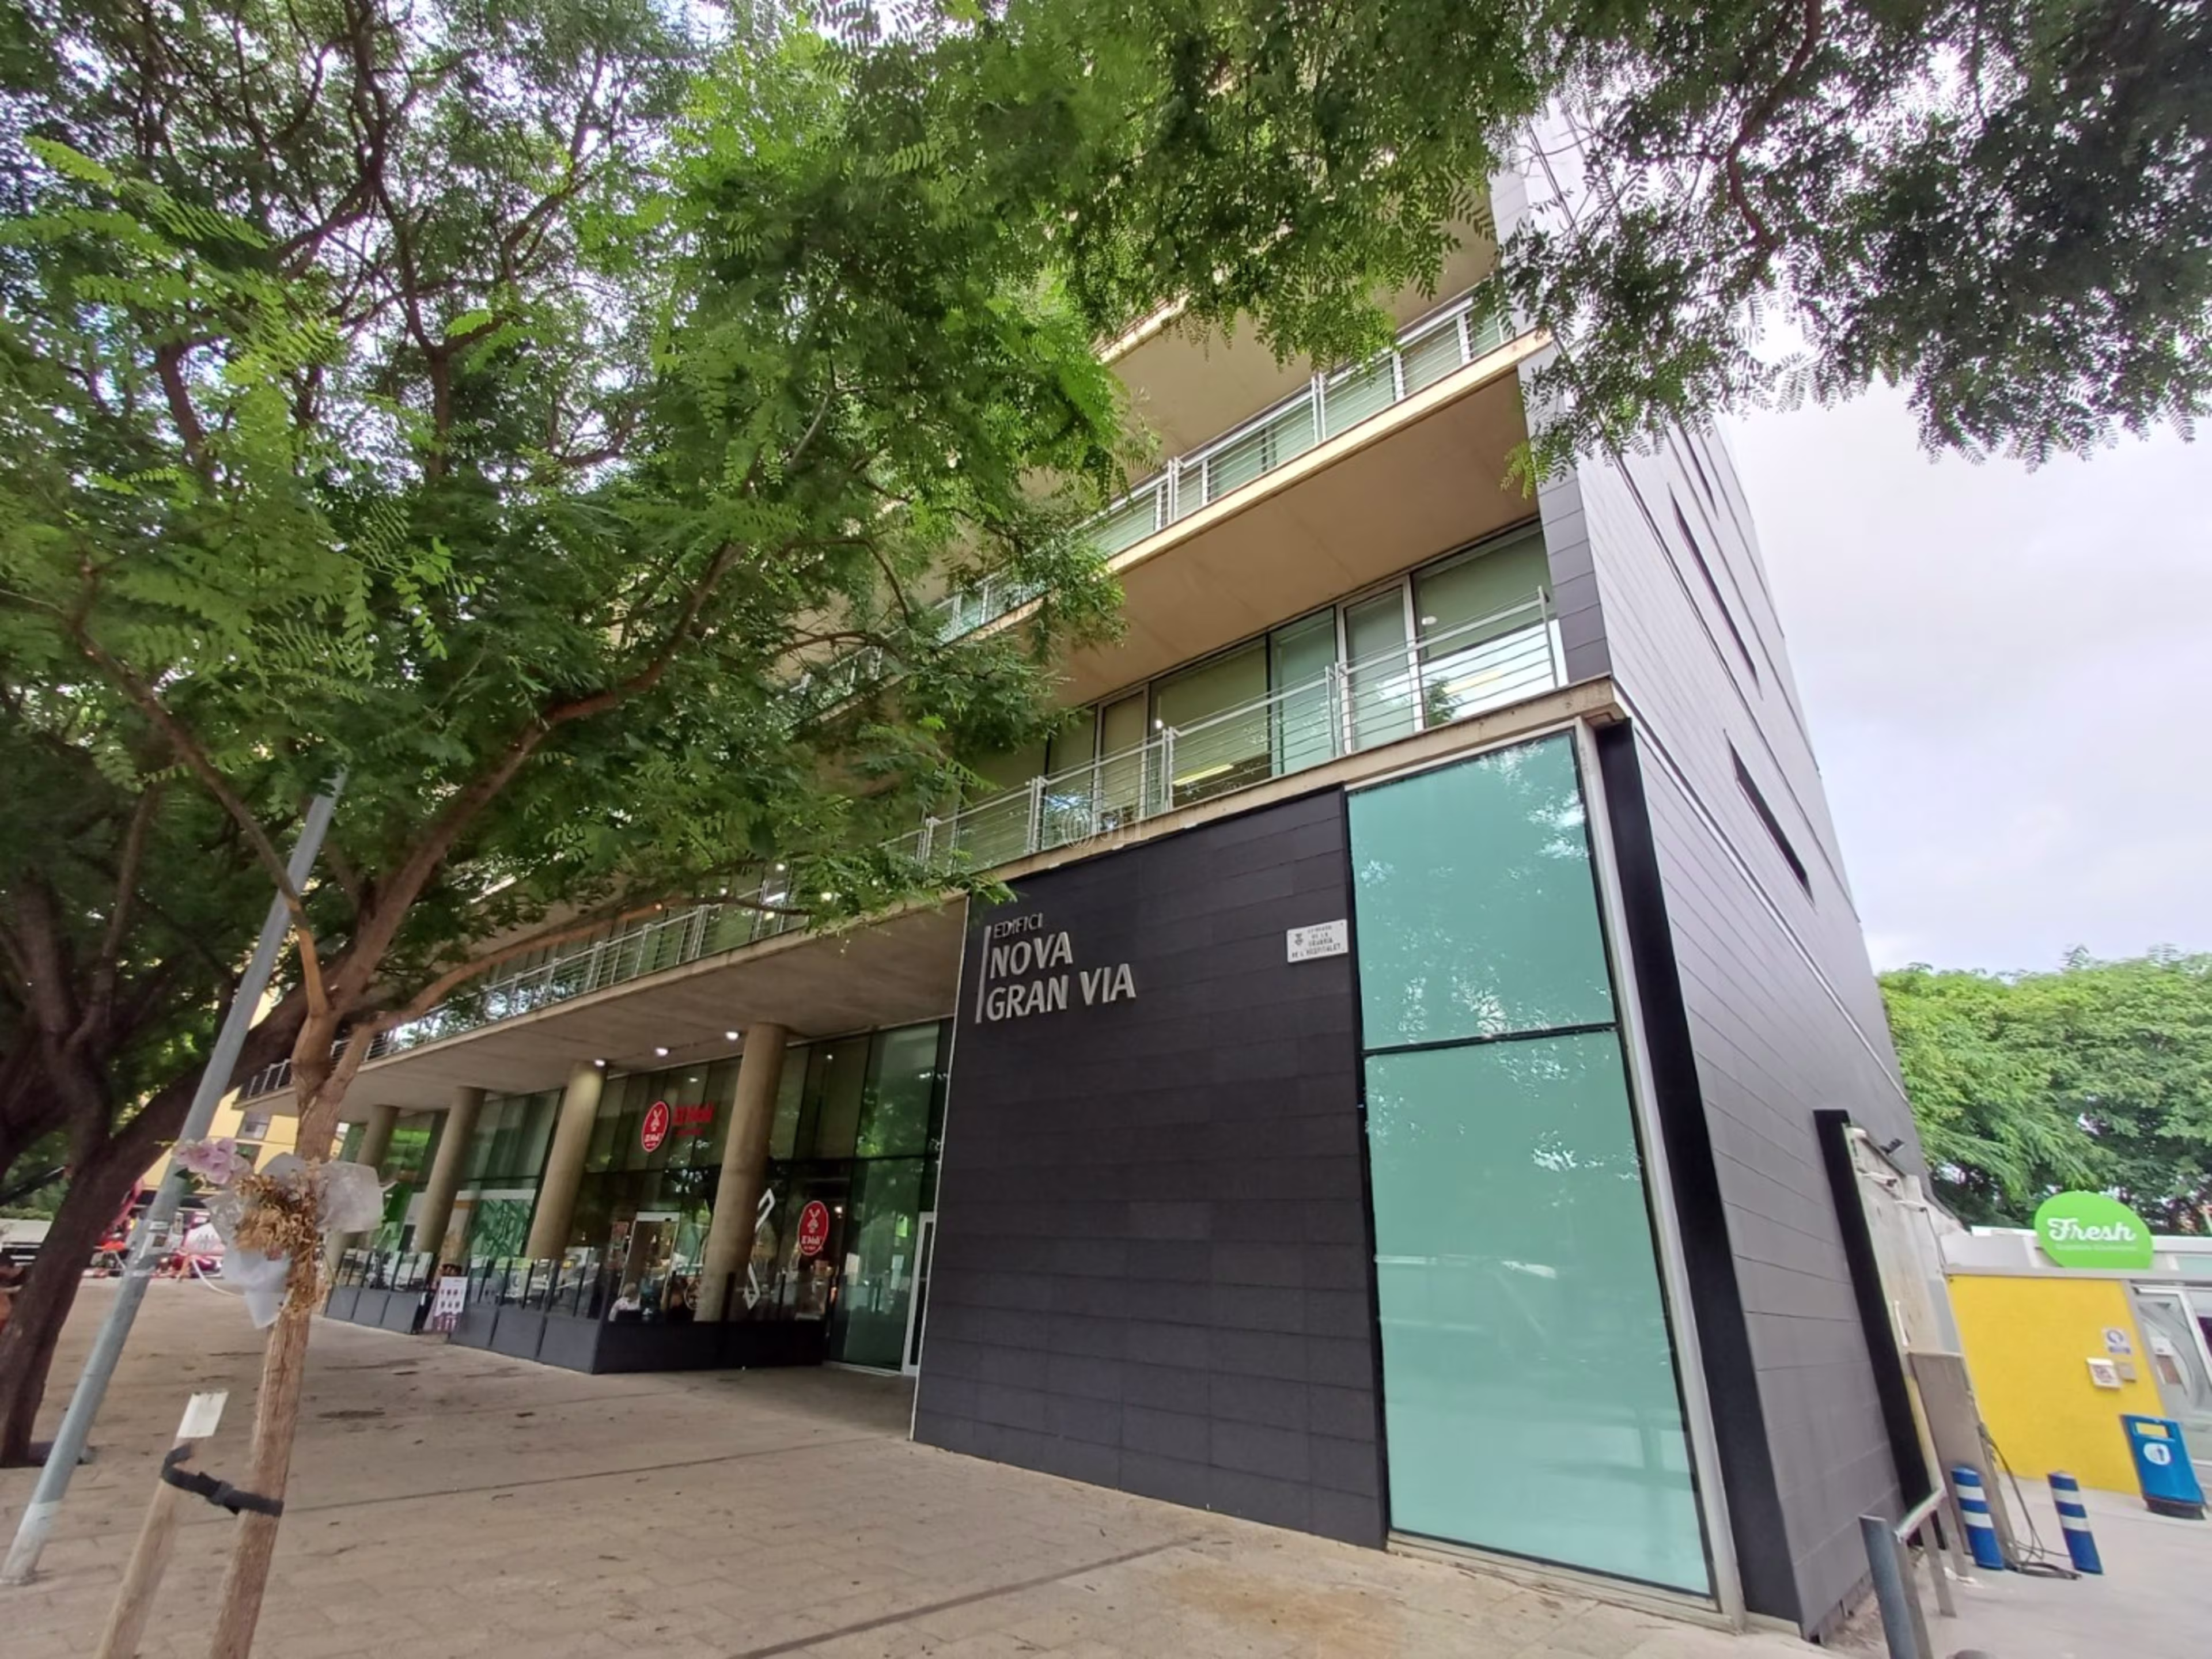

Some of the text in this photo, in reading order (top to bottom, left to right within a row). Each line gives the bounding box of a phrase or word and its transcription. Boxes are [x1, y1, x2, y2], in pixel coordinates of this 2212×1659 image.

[993, 912, 1043, 939] EDIFICI
[990, 931, 1073, 979] NOVA
[986, 963, 1137, 1021] GRAN VIA
[2047, 1218, 2137, 1241] Fresh
